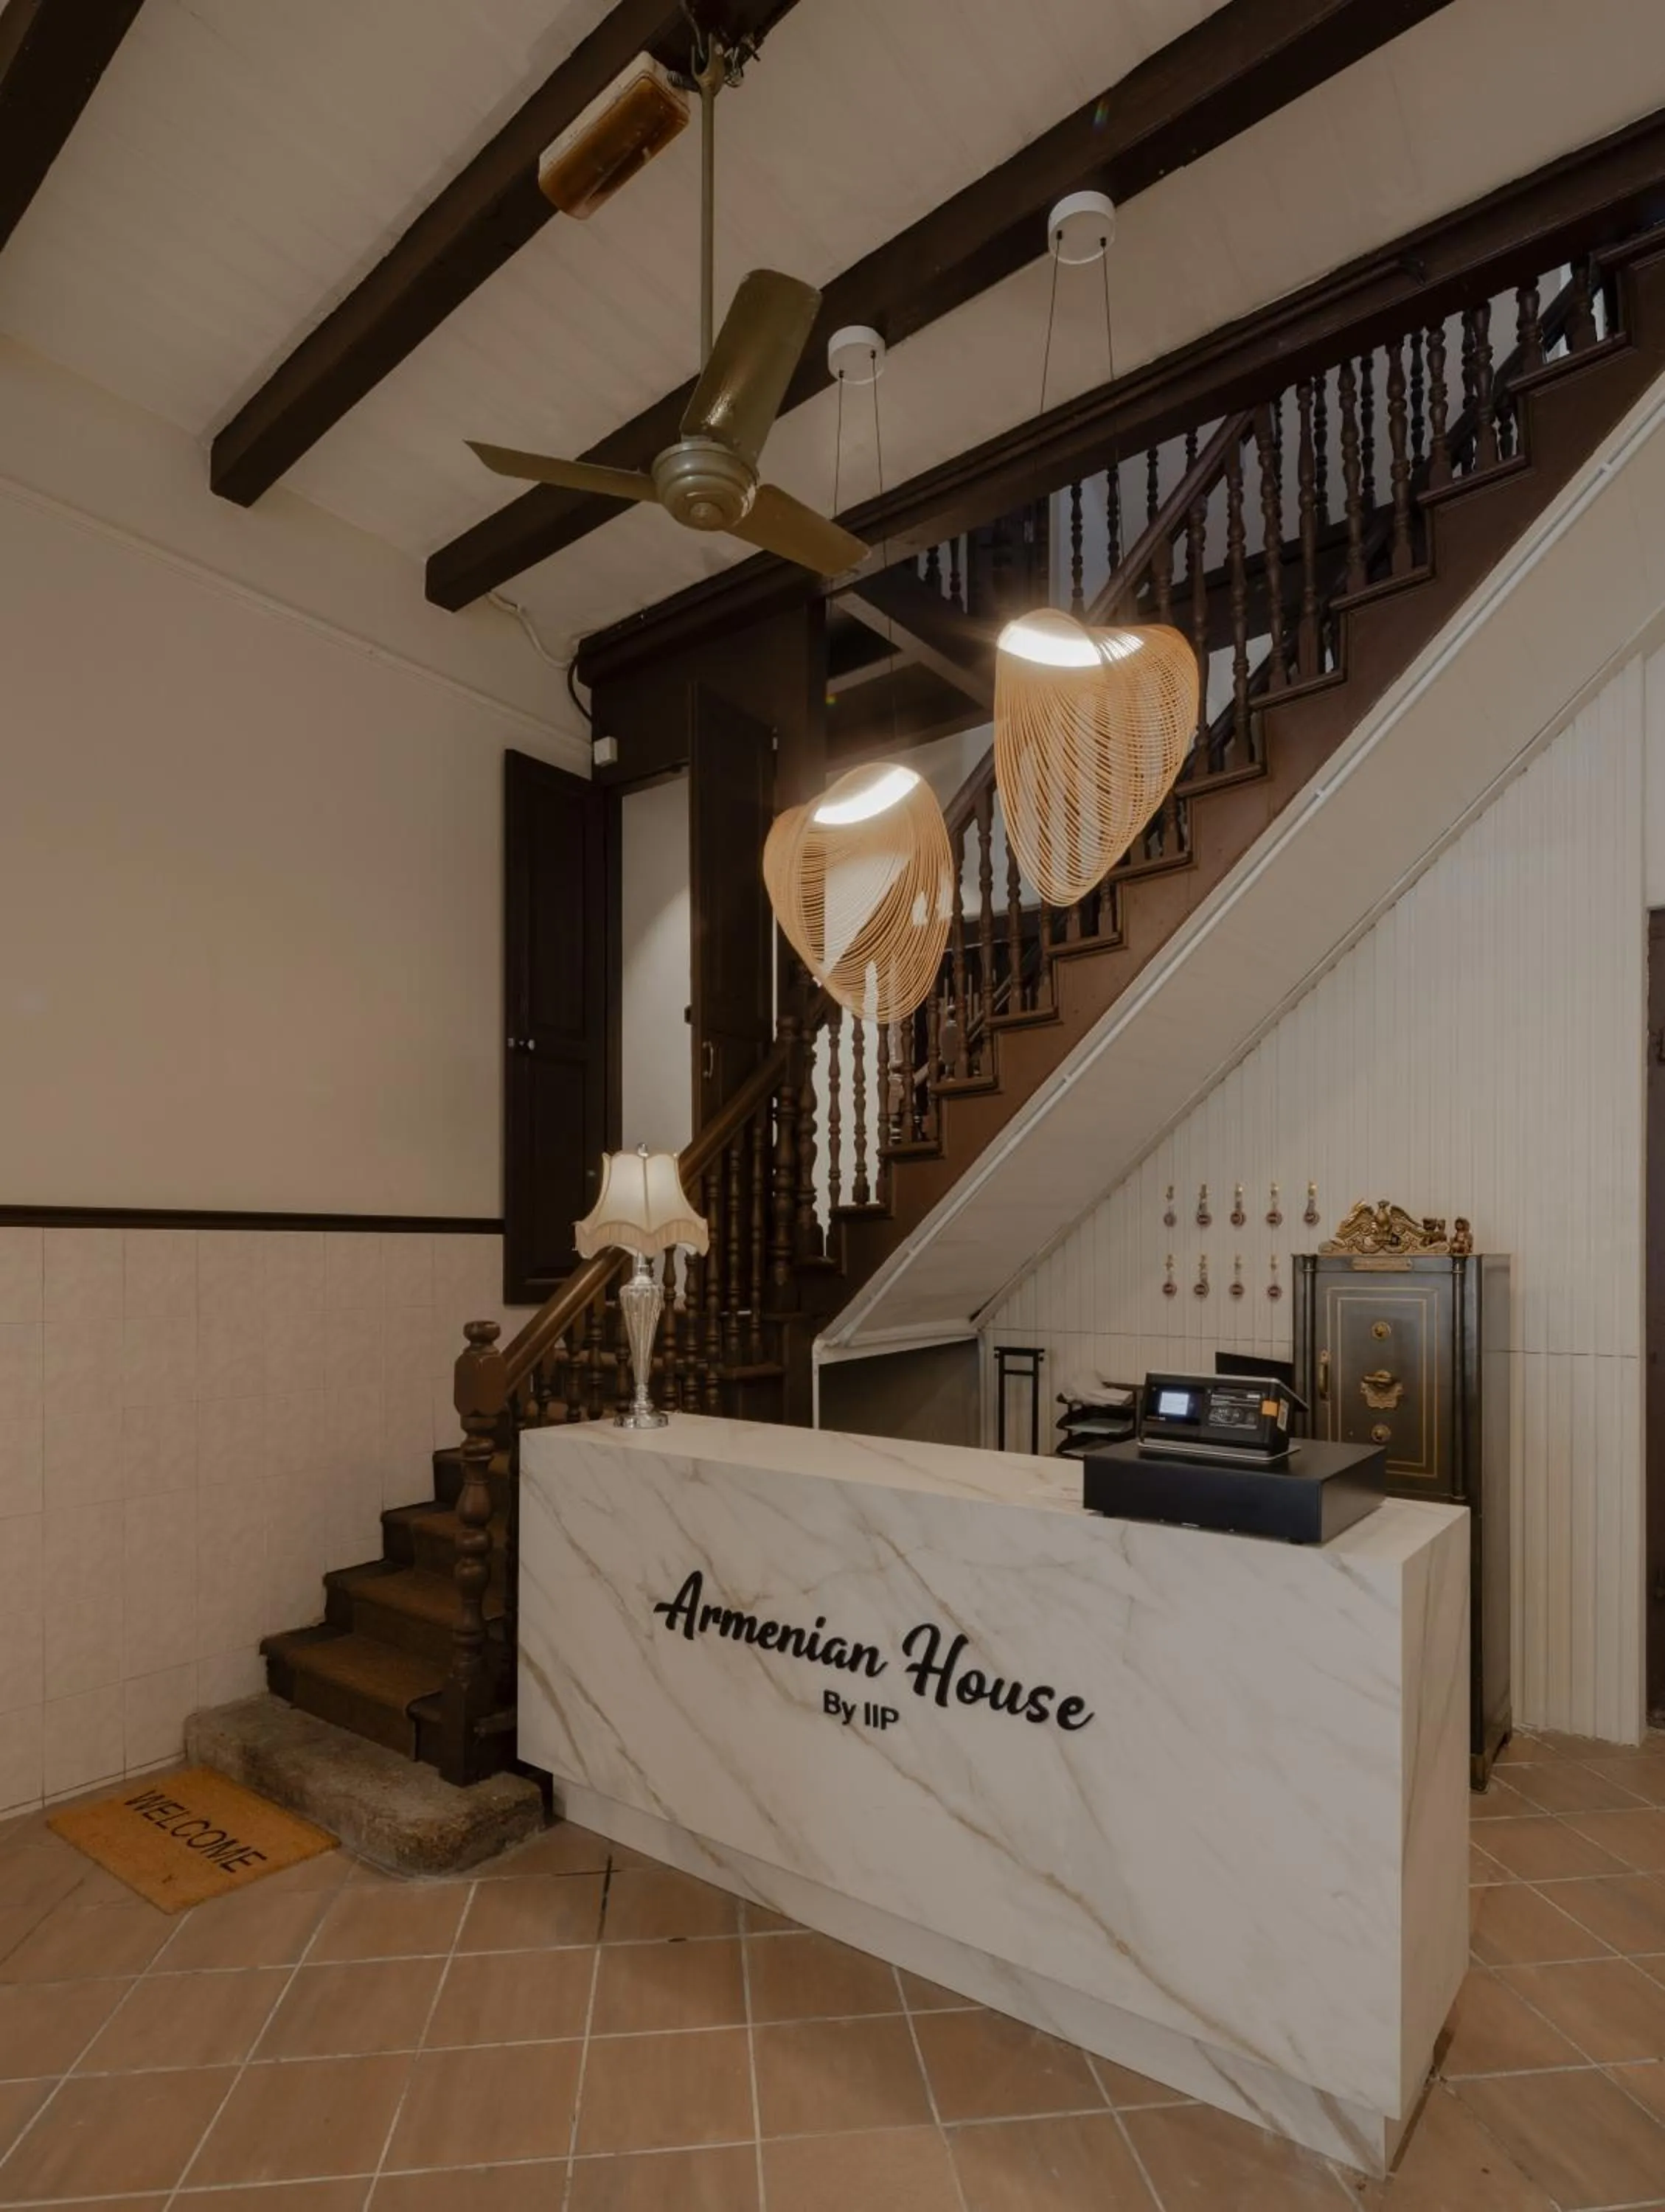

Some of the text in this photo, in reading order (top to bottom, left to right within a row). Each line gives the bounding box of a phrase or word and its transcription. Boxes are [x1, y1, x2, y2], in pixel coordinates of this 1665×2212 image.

[653, 1570, 1094, 1731] Armenian House
[823, 1689, 857, 1726] By
[124, 1789, 268, 1874] WELCOME
